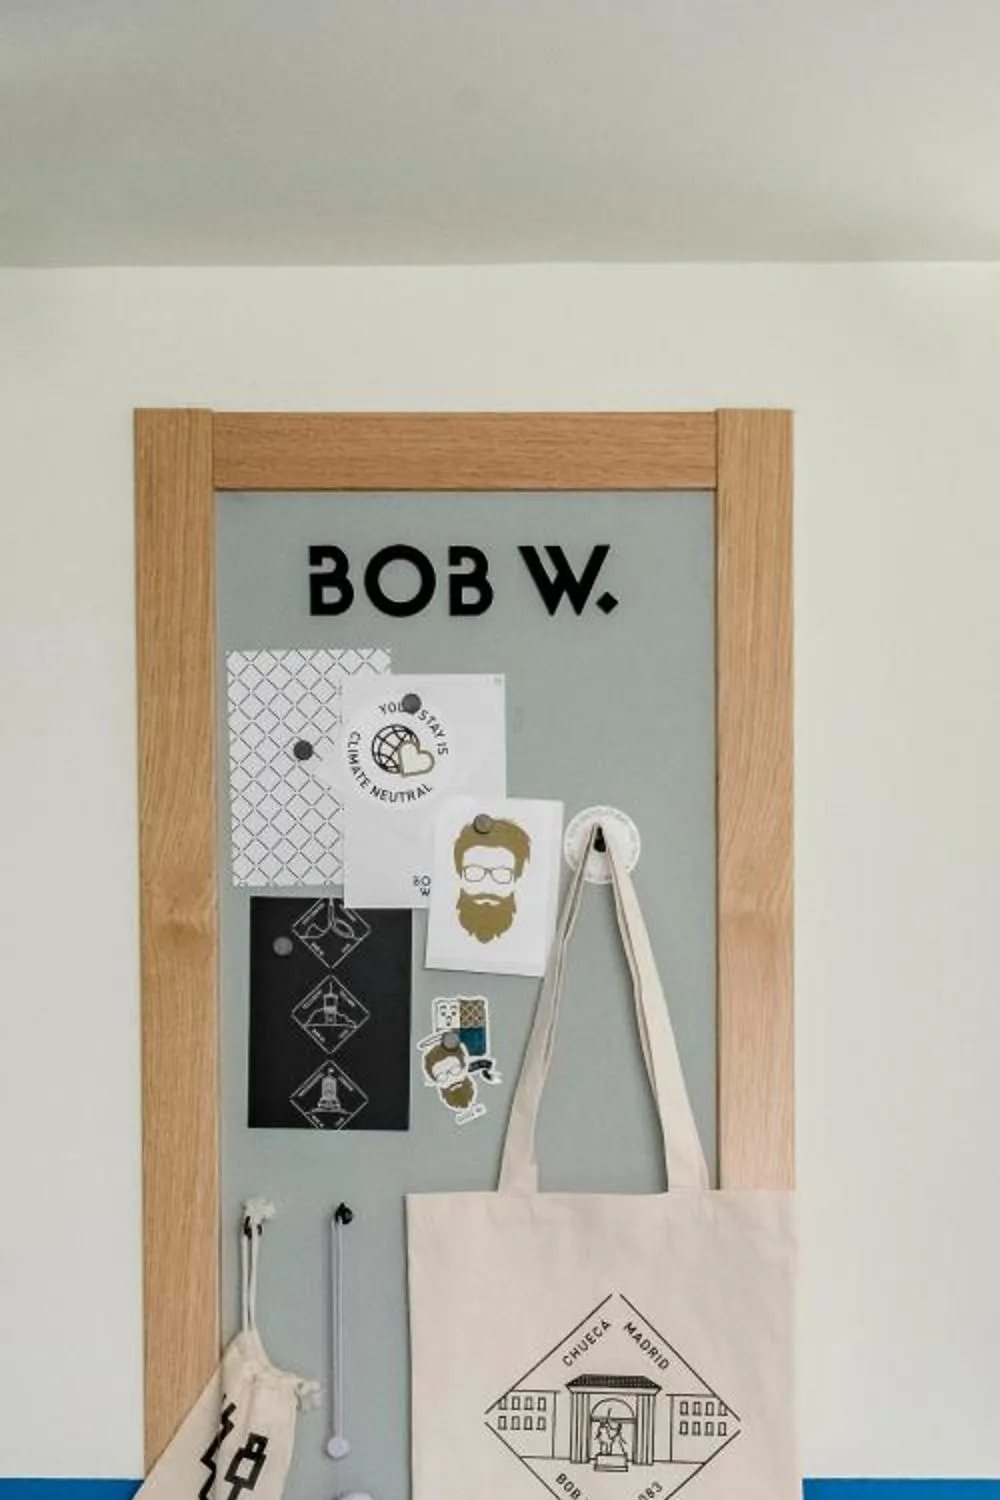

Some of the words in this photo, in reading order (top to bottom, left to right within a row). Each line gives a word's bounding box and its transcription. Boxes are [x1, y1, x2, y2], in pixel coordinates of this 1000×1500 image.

[308, 544, 493, 618] BOB
[517, 544, 619, 617] W.
[417, 709, 446, 738] STAY
[347, 731, 371, 790] CLIMATE
[369, 783, 433, 803] NEUTRAL
[561, 1319, 612, 1367] CHUECA
[623, 1321, 670, 1371] MADRID
[555, 1473, 581, 1500] BOB
